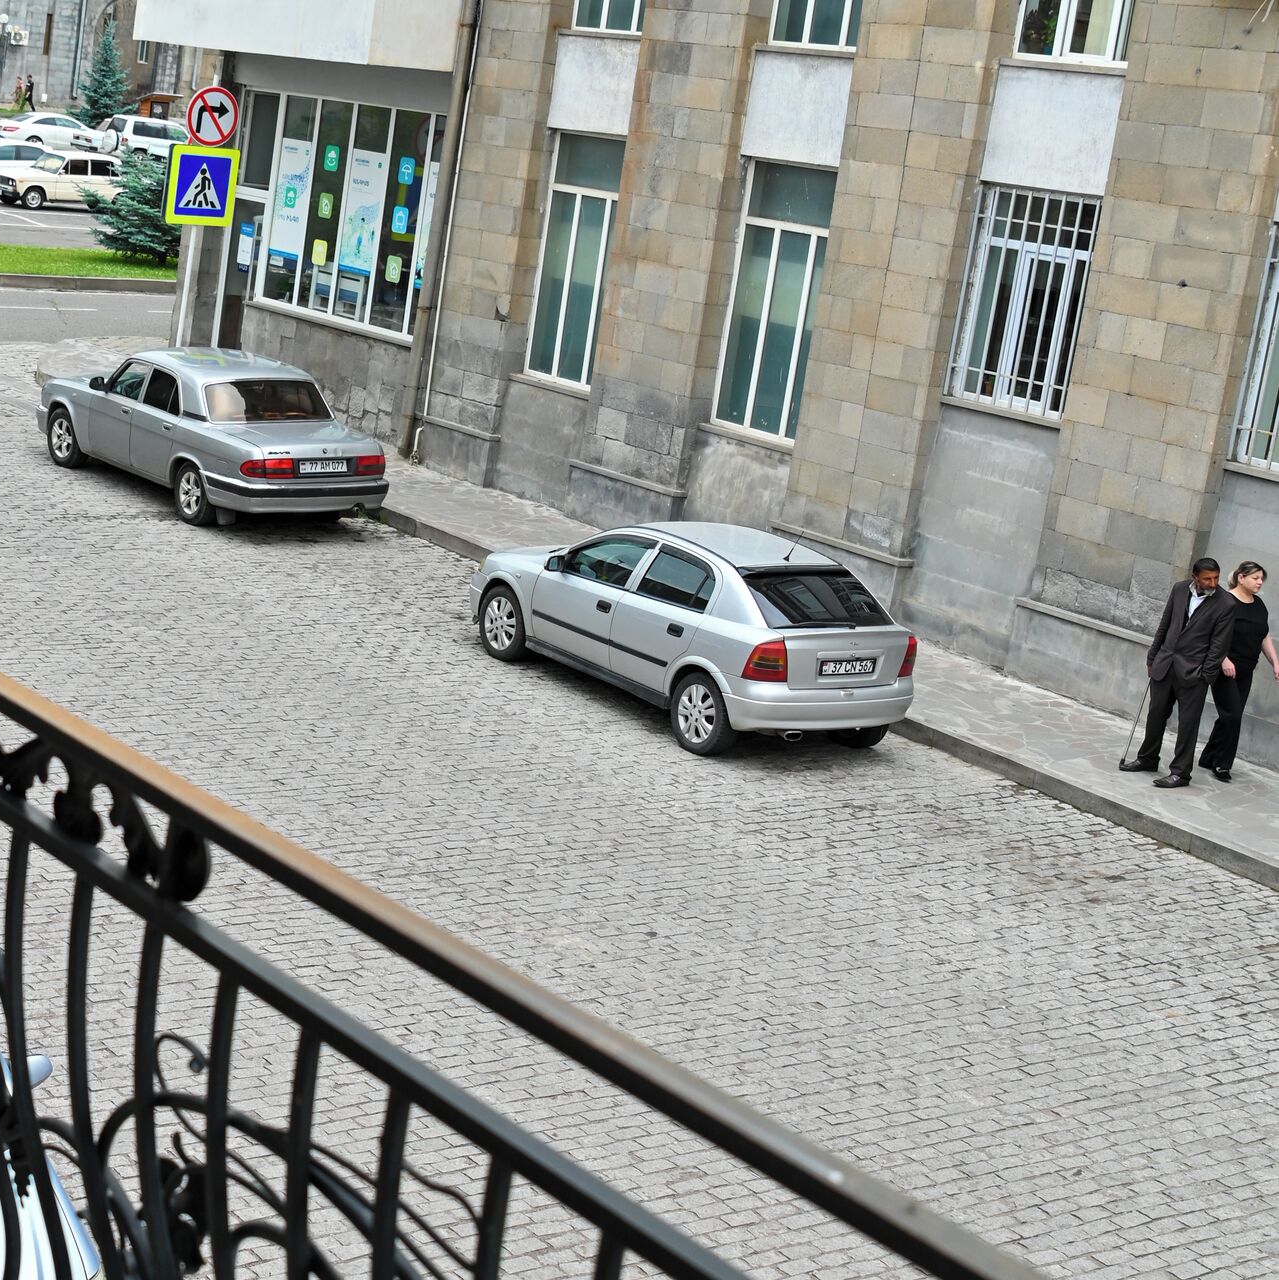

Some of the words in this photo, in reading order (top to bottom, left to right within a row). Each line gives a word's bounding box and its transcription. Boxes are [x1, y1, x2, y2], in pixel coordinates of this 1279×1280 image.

[309, 462, 319, 471] 77
[320, 461, 331, 471] AM
[331, 460, 345, 471] 077
[831, 662, 843, 674] 37
[844, 661, 857, 673] CN
[858, 660, 874, 672] 567
